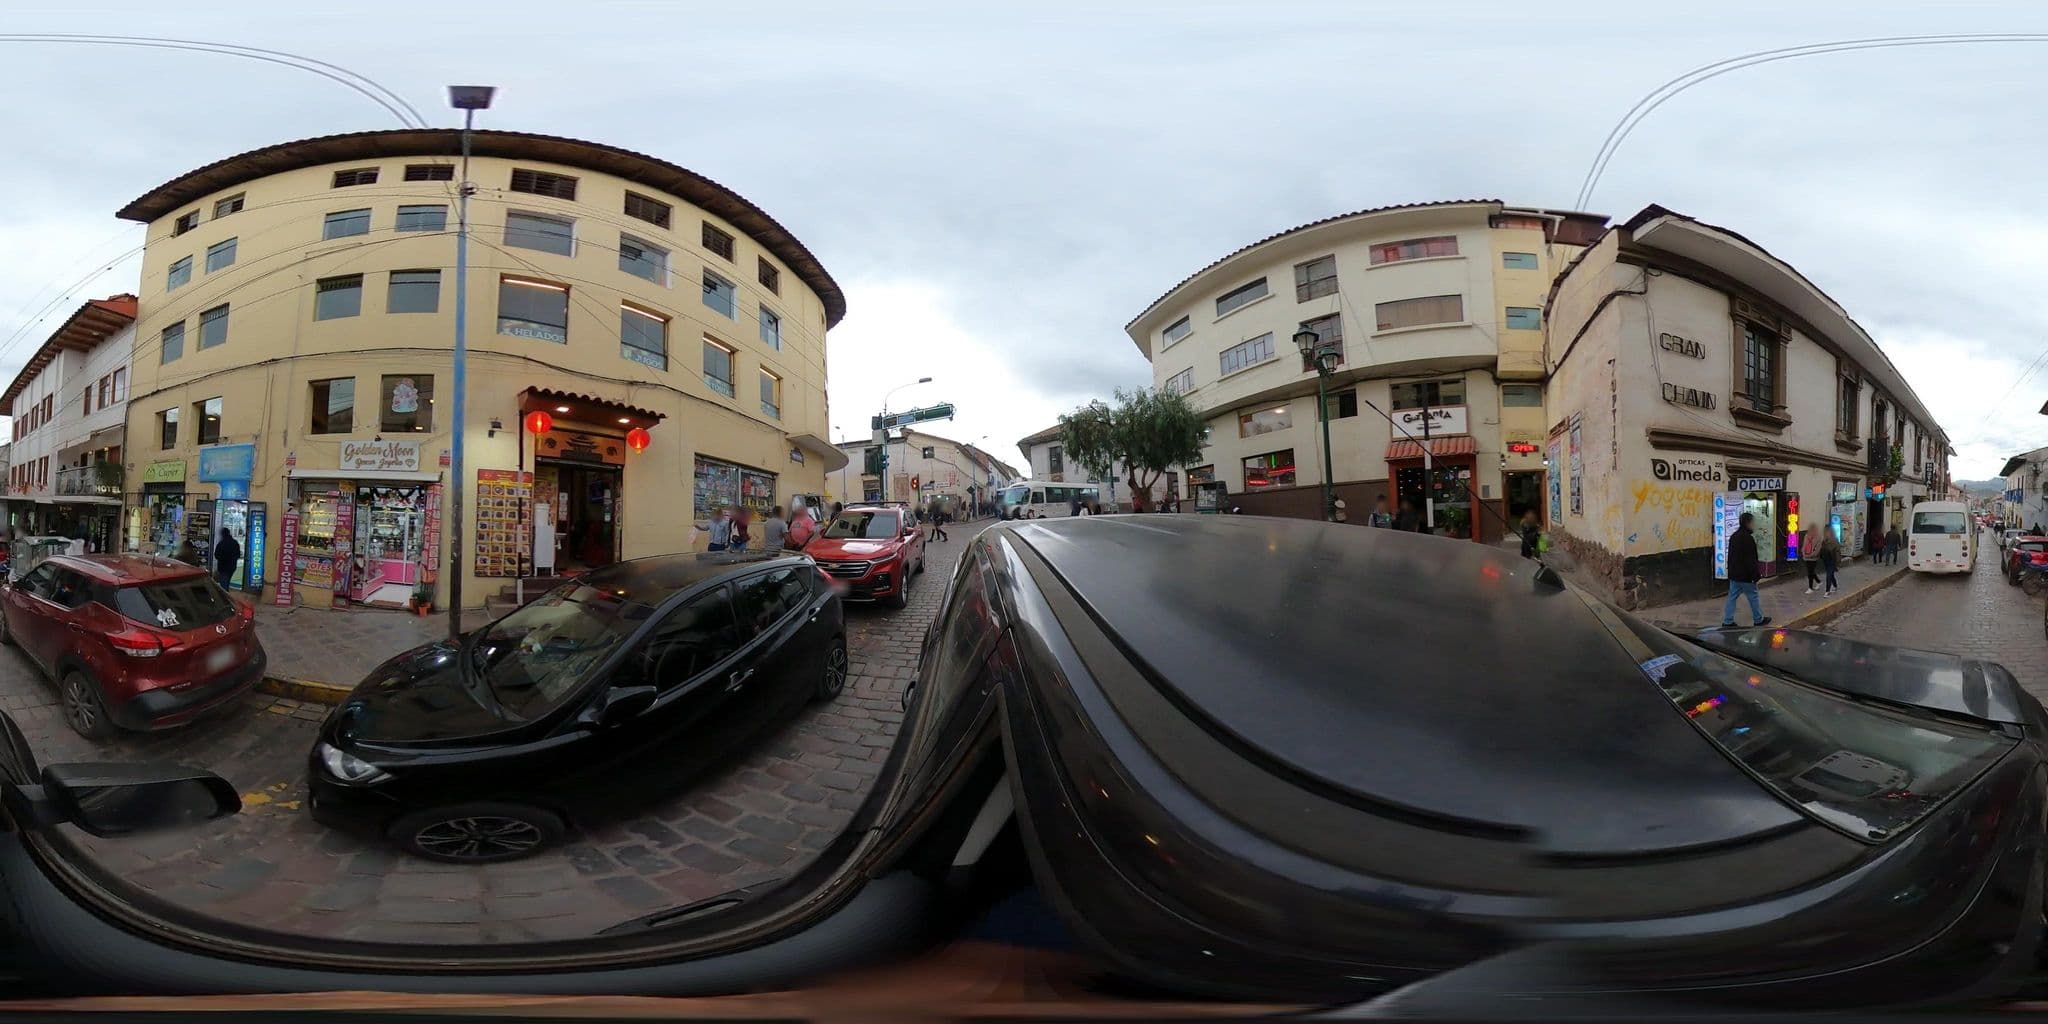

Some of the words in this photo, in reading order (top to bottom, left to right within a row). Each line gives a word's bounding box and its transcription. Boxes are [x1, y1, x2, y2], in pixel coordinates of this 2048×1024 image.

[515, 328, 566, 343] HELADOS
[1660, 332, 1706, 360] GRAN
[1662, 382, 1717, 410] CHAVIN
[344, 442, 382, 462] Golden
[383, 442, 415, 460] Moon
[1678, 459, 1706, 467] OPTICAS
[96, 485, 121, 494] HOTEL
[1739, 479, 1782, 490] OPTICA
[1715, 497, 1725, 577] OPTICA
[252, 520, 263, 580] MATRIMONIO
[281, 519, 296, 594] PERFORACIONES
